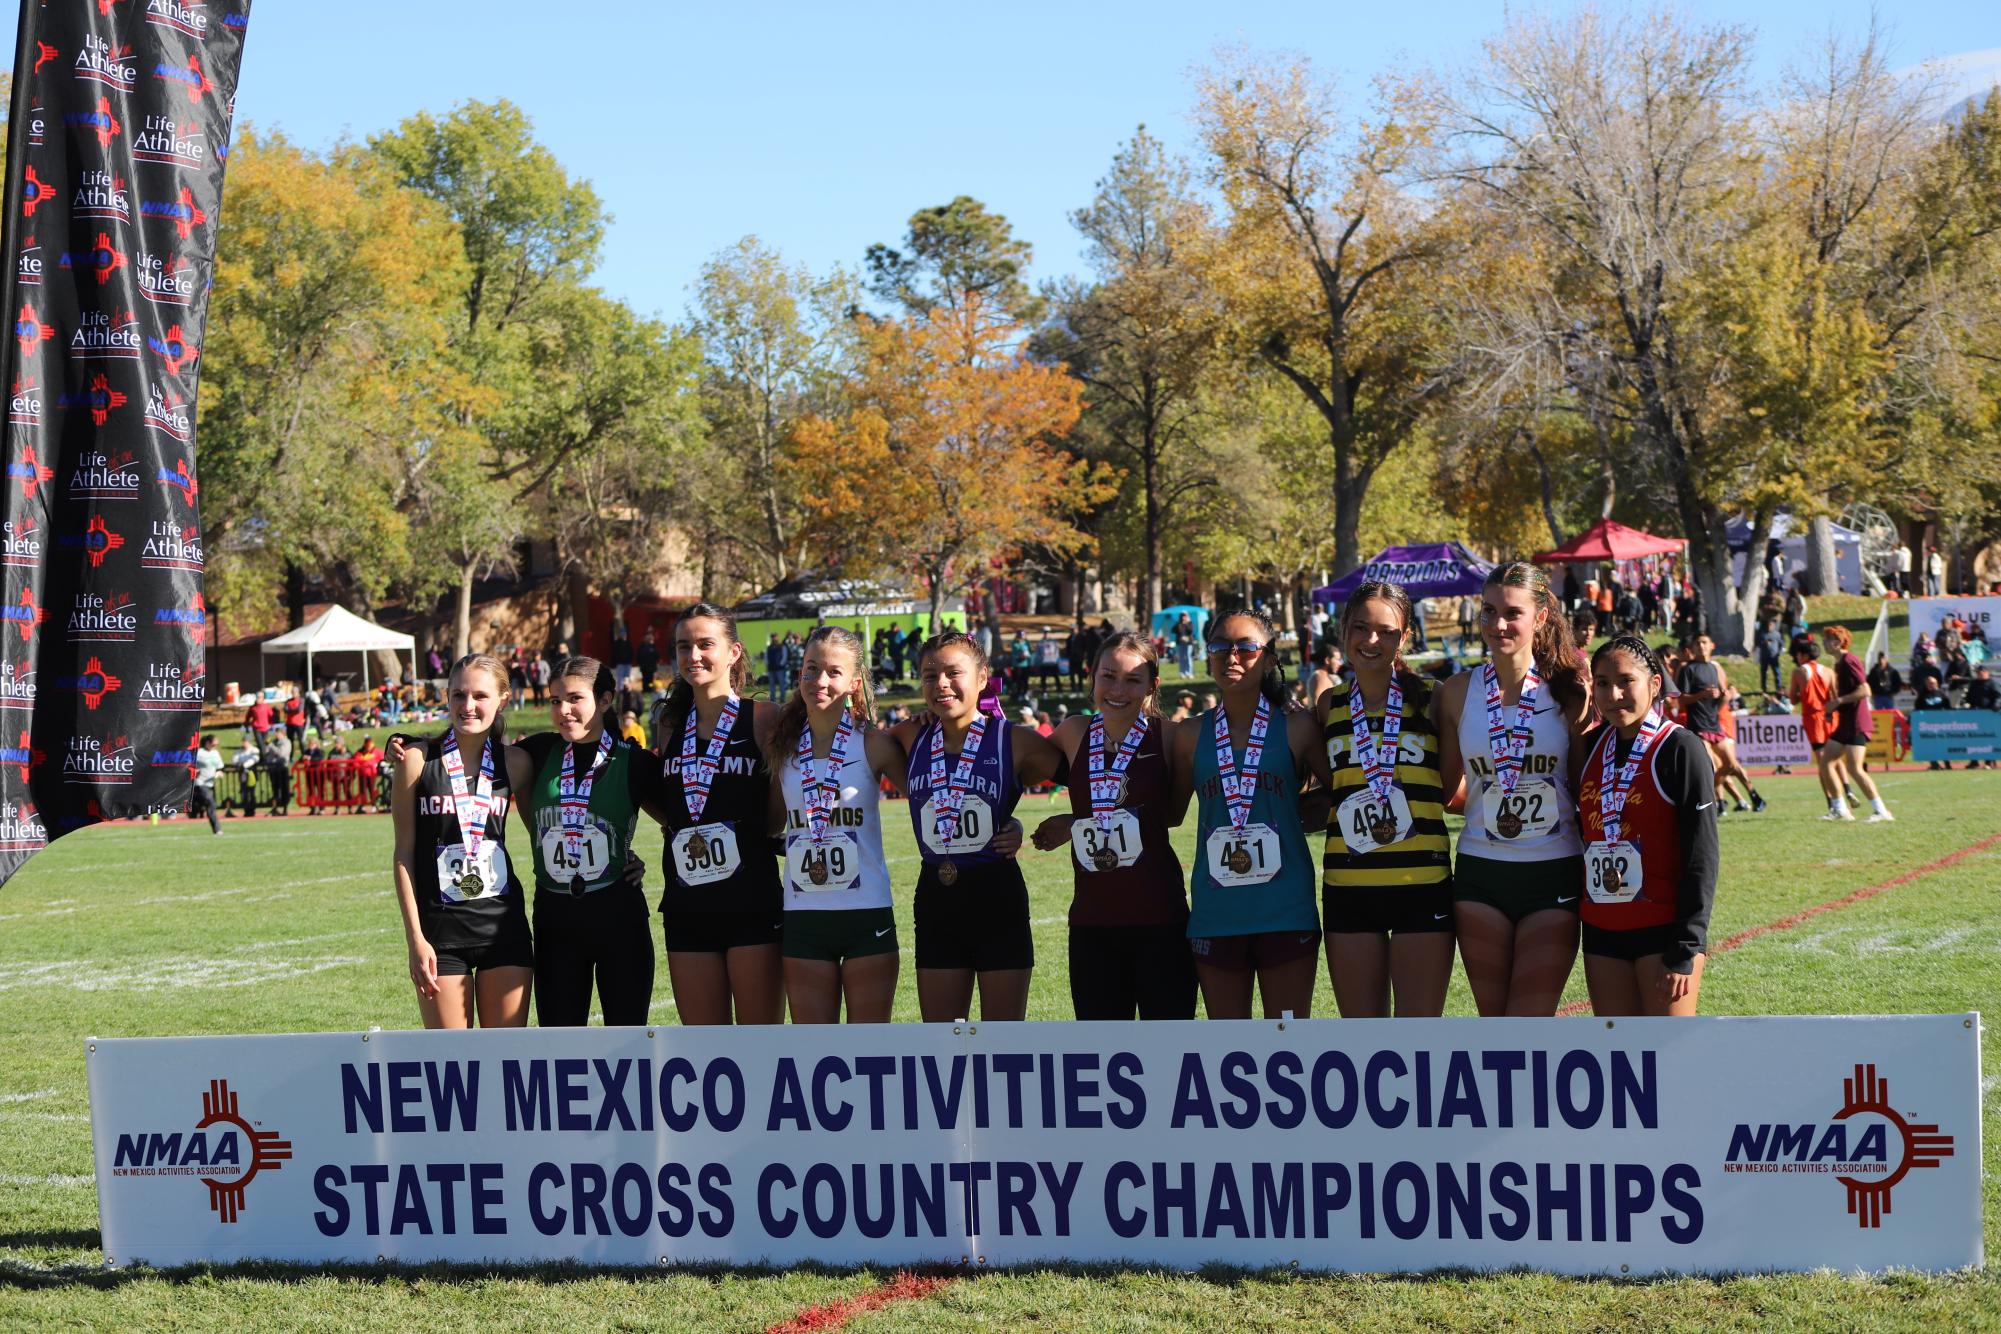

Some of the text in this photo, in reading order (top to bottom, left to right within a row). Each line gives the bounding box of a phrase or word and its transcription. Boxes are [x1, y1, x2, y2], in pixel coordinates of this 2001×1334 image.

[86, 34, 109, 54] Life
[75, 49, 136, 81] Athlete
[146, 115, 175, 132] Life
[134, 131, 202, 158] Athlete
[83, 171, 111, 186] Life
[137, 252, 162, 270] Life
[82, 311, 109, 326] Life
[72, 327, 141, 347] Athlete
[80, 451, 107, 466] Life
[71, 468, 139, 487] Athlete
[153, 521, 181, 536] Life
[142, 537, 203, 561] Athlete
[1362, 559, 1460, 583] PATRIOTS
[76, 593, 103, 608] Life
[68, 610, 136, 629] Athlete
[150, 663, 180, 678] Life
[71, 736, 100, 751] Life
[64, 752, 133, 772] Athlete
[420, 795, 507, 816] ACAMY
[1496, 794, 1545, 824] 422
[1353, 797, 1398, 837] 464
[341, 1050, 1658, 1133] NEW MEXICO ACTIVITIES ASSOCIATION
[114, 1131, 240, 1167] NMAA
[1725, 1124, 1887, 1162] NMAA
[113, 1166, 241, 1176] NEW MEXICO ACTIVITIES ASSOCIATION
[1724, 1163, 1888, 1173] NEW MEXICO ACTIVITIES ASSOCIATION
[314, 1161, 1704, 1245] STATE CROSS COUNTRY CHAMPIONSHIPS
